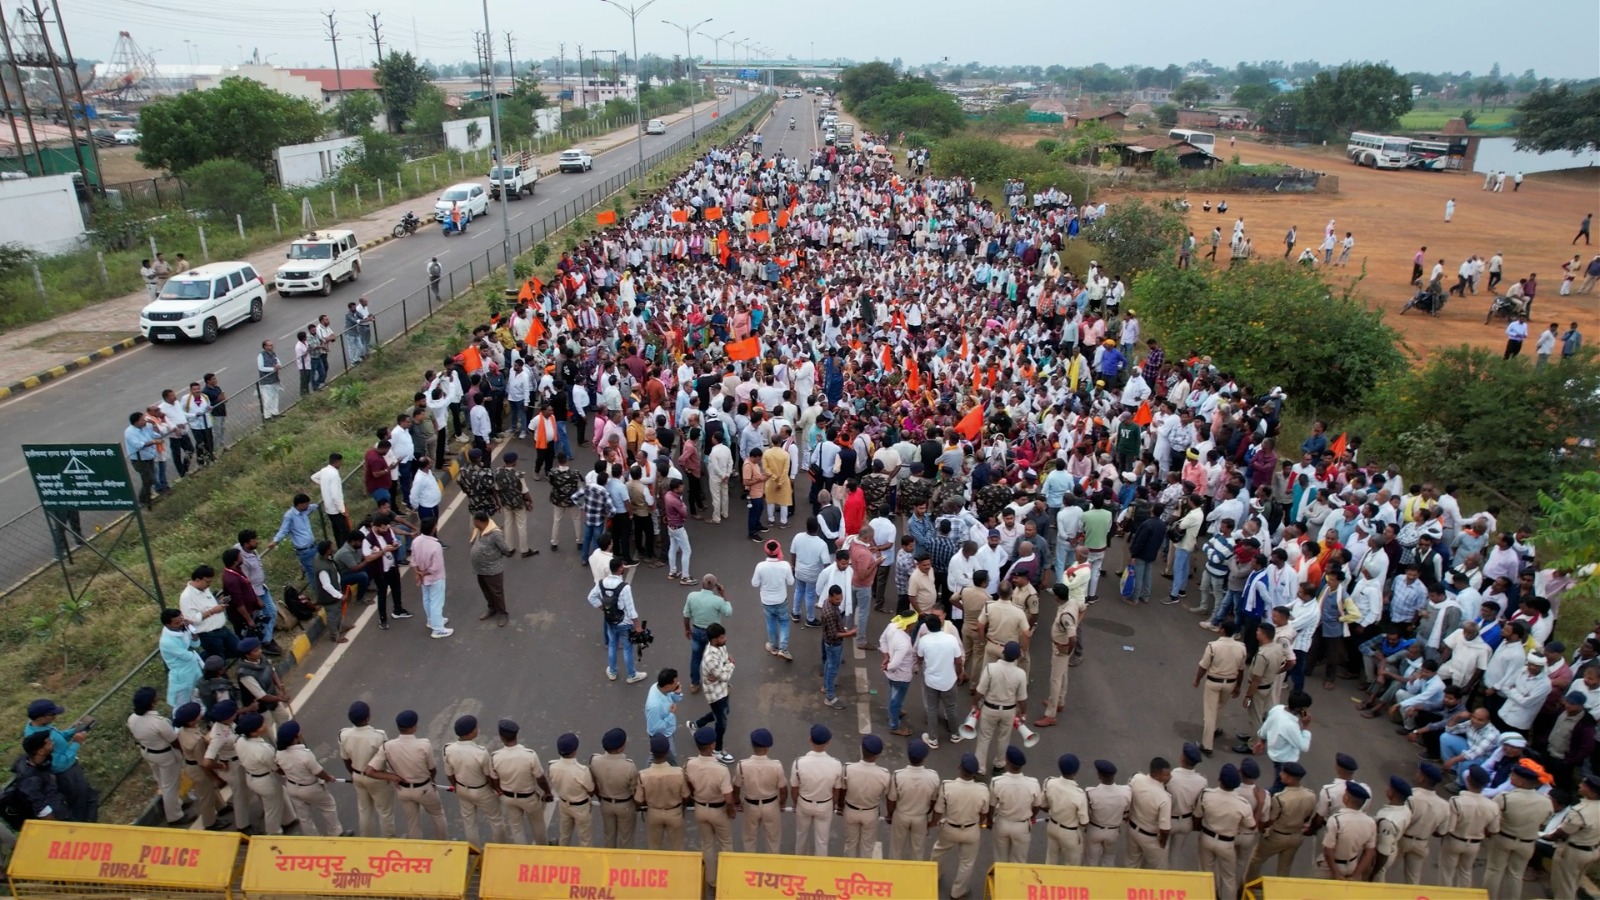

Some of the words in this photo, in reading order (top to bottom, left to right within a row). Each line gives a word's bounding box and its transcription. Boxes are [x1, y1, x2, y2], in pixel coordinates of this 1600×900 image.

[48, 840, 113, 861] RAIPUR
[138, 844, 200, 867] POLICE
[275, 855, 347, 878] रायपुर
[368, 849, 433, 878] पुलिस
[98, 861, 148, 879] RURAL
[331, 867, 372, 889] ग्रामीण
[518, 863, 581, 884] RAIPUR
[608, 868, 669, 888] POLICE
[569, 884, 616, 900] RURAL
[745, 870, 808, 896] रायपुर
[834, 872, 893, 900] पुलिस
